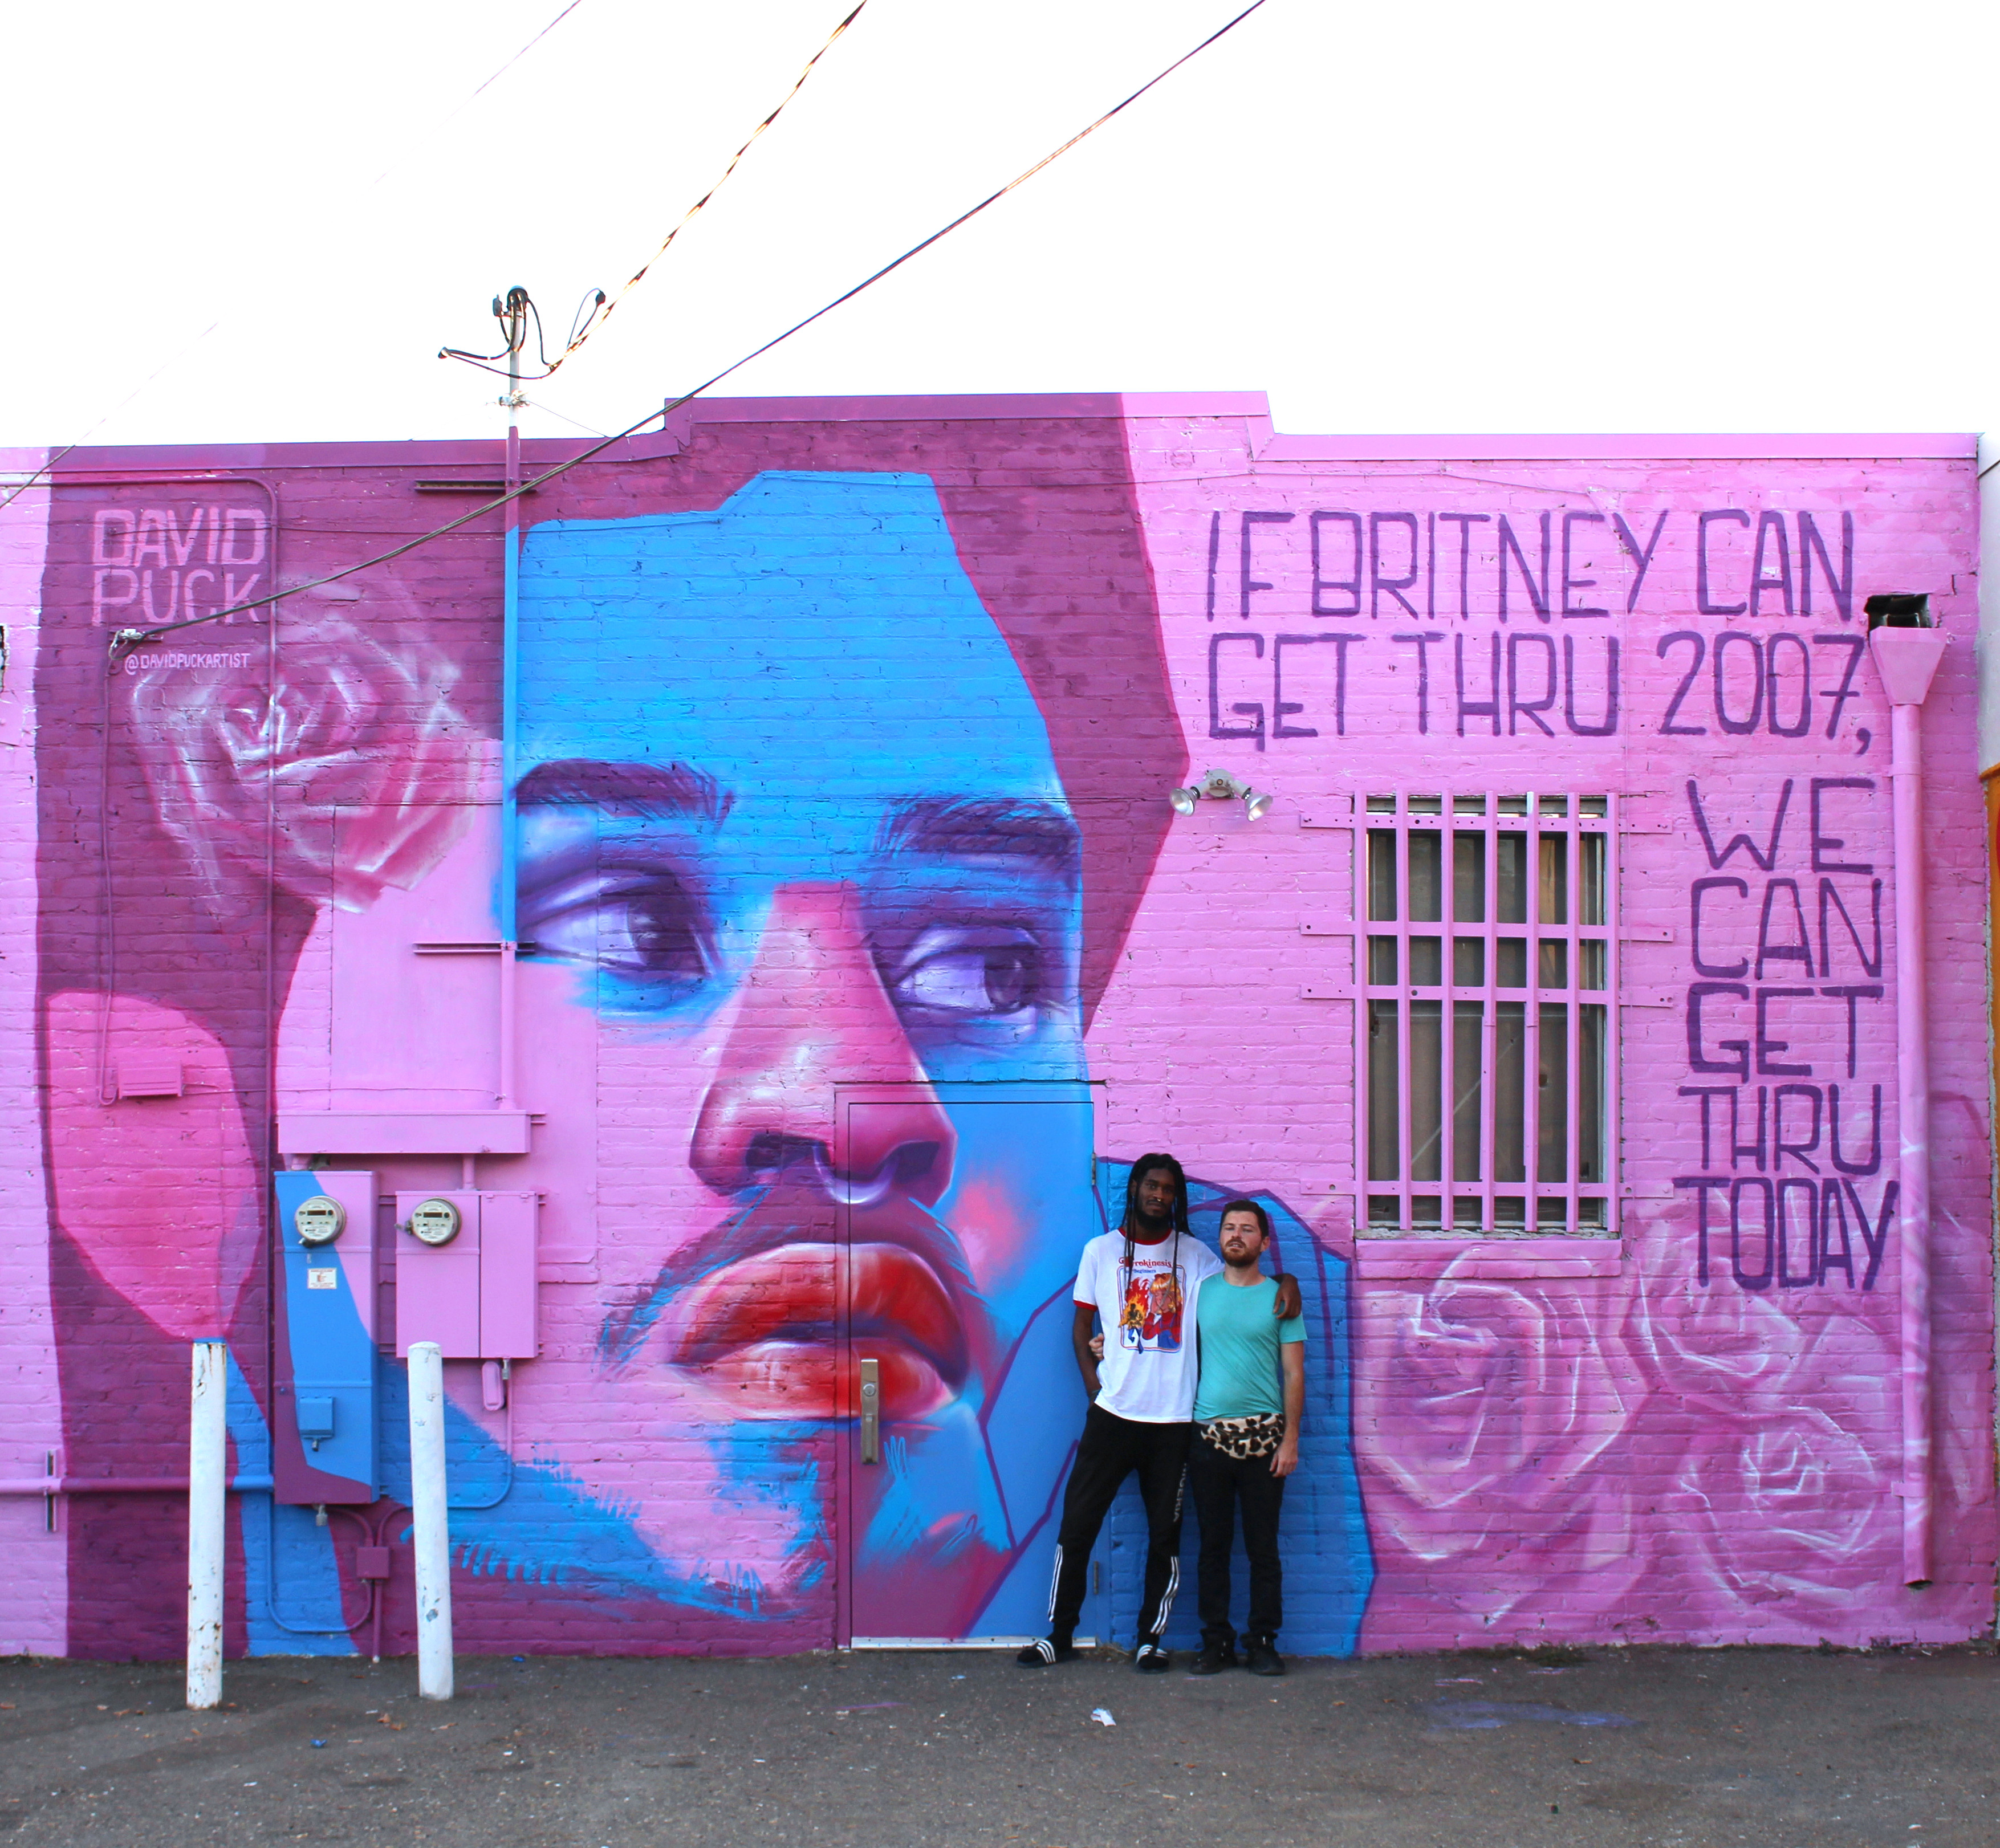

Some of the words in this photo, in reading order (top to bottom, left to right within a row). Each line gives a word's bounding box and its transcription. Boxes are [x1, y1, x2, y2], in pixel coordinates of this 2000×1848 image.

[92, 507, 267, 569] DAVID
[1207, 510, 1296, 621] IF
[1310, 510, 1668, 623] BRITNEY
[1698, 509, 1853, 622] CAN
[91, 569, 262, 626] PUCK
[125, 653, 251, 675] @DAVIDPUCKARTIST
[1208, 632, 1367, 751] GET
[1392, 631, 1620, 737] THRU
[1656, 631, 1872, 756] 2007,
[1686, 778, 1876, 874] WE
[1690, 877, 1883, 979] CAN
[1686, 982, 1885, 1083] GET
[1678, 1084, 1883, 1175] THRU
[1119, 1256, 1174, 1268] rokinesis
[1672, 1176, 1900, 1291] TODAY
